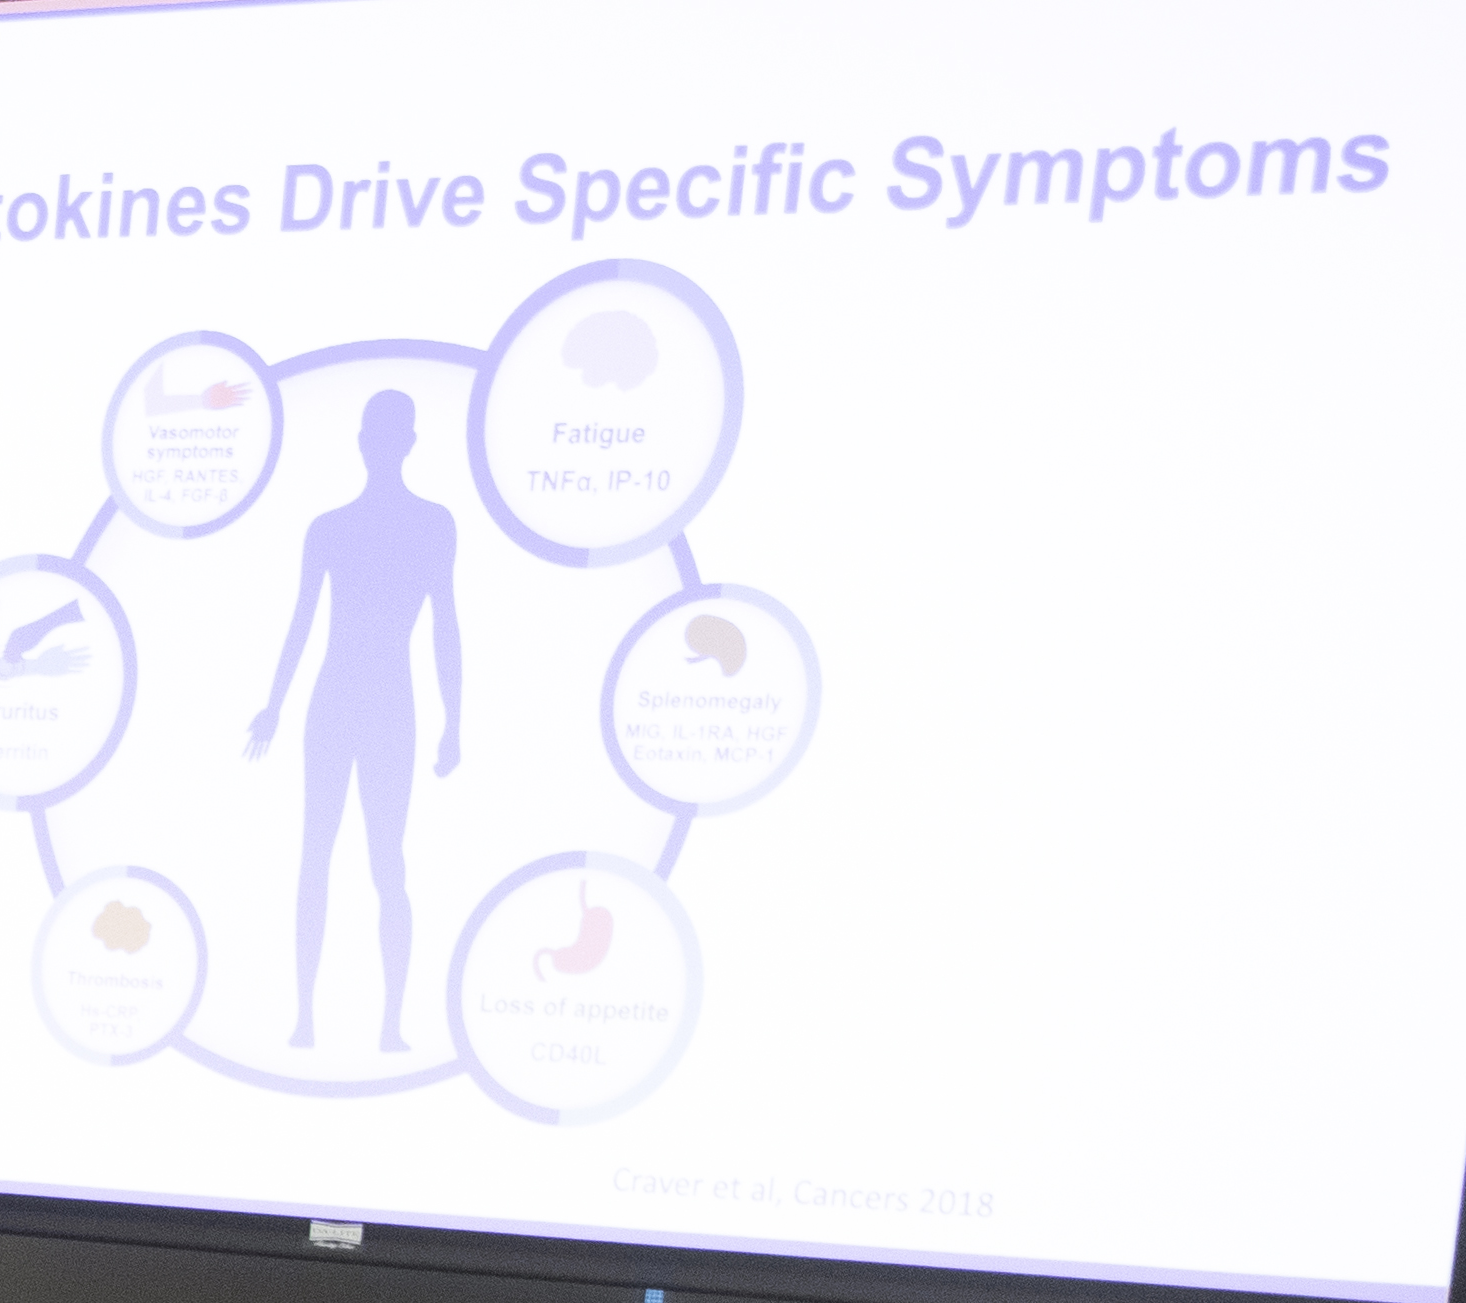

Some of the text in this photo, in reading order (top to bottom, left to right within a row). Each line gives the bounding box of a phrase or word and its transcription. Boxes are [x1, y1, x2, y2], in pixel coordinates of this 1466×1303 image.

[278, 157, 488, 236] Drive
[513, 141, 858, 242] Specific
[882, 128, 1392, 228] Symptoms
[148, 424, 240, 440] Vasomotor
[551, 422, 646, 450] Fatigue
[146, 445, 234, 462] symptoms
[607, 469, 671, 492] IP-10
[637, 690, 783, 714] Splenomegaly
[713, 747, 775, 763] MCP-1
[67, 971, 164, 990] Thrombosis
[479, 993, 670, 1024] Loss of appetite
[530, 1041, 607, 1066] CD40L
[612, 1166, 995, 1219] Craver et al, Cancers 2018
